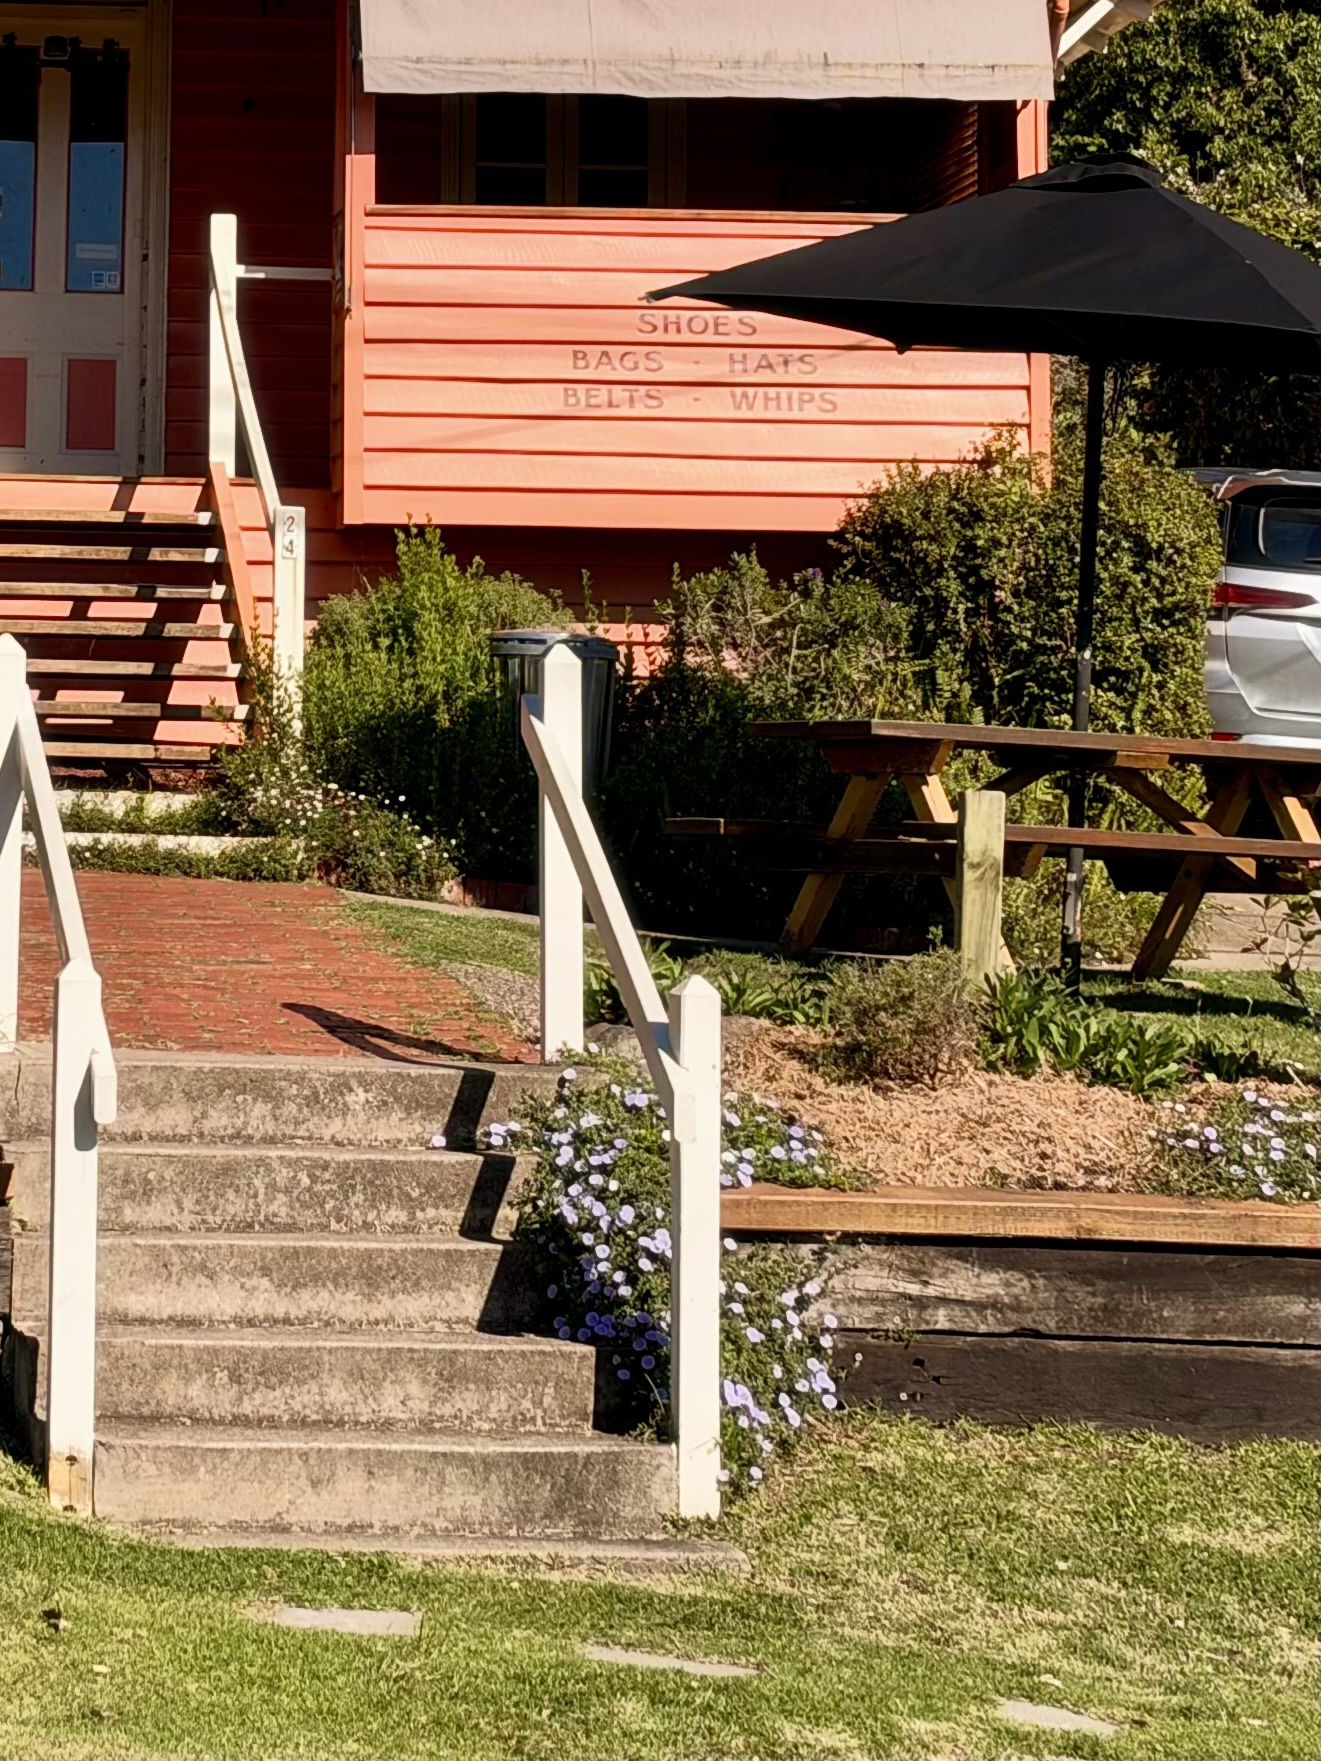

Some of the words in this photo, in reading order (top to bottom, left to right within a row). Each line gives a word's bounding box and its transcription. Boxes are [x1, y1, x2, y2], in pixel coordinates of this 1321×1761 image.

[636, 313, 758, 336] SHOES
[572, 350, 664, 373] BAGS
[728, 353, 818, 375] HATS
[562, 387, 664, 409] BELTS
[729, 390, 838, 413] WHIPS
